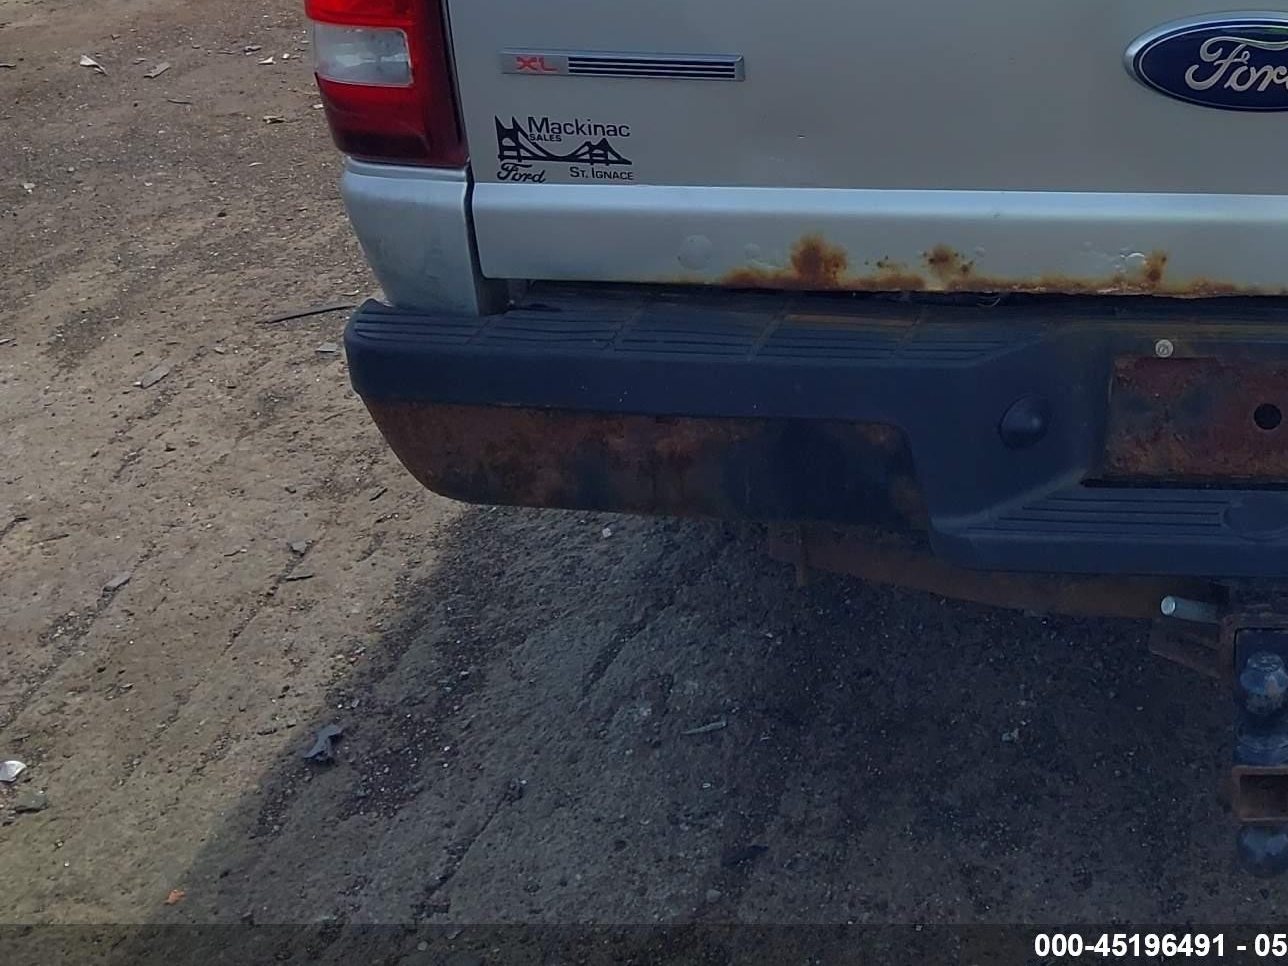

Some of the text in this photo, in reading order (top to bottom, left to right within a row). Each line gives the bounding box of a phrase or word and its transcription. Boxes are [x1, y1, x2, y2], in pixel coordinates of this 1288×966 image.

[515, 56, 558, 72] XL
[527, 116, 630, 137] Mackinac
[529, 133, 562, 142] SALES
[497, 162, 546, 183] Ford
